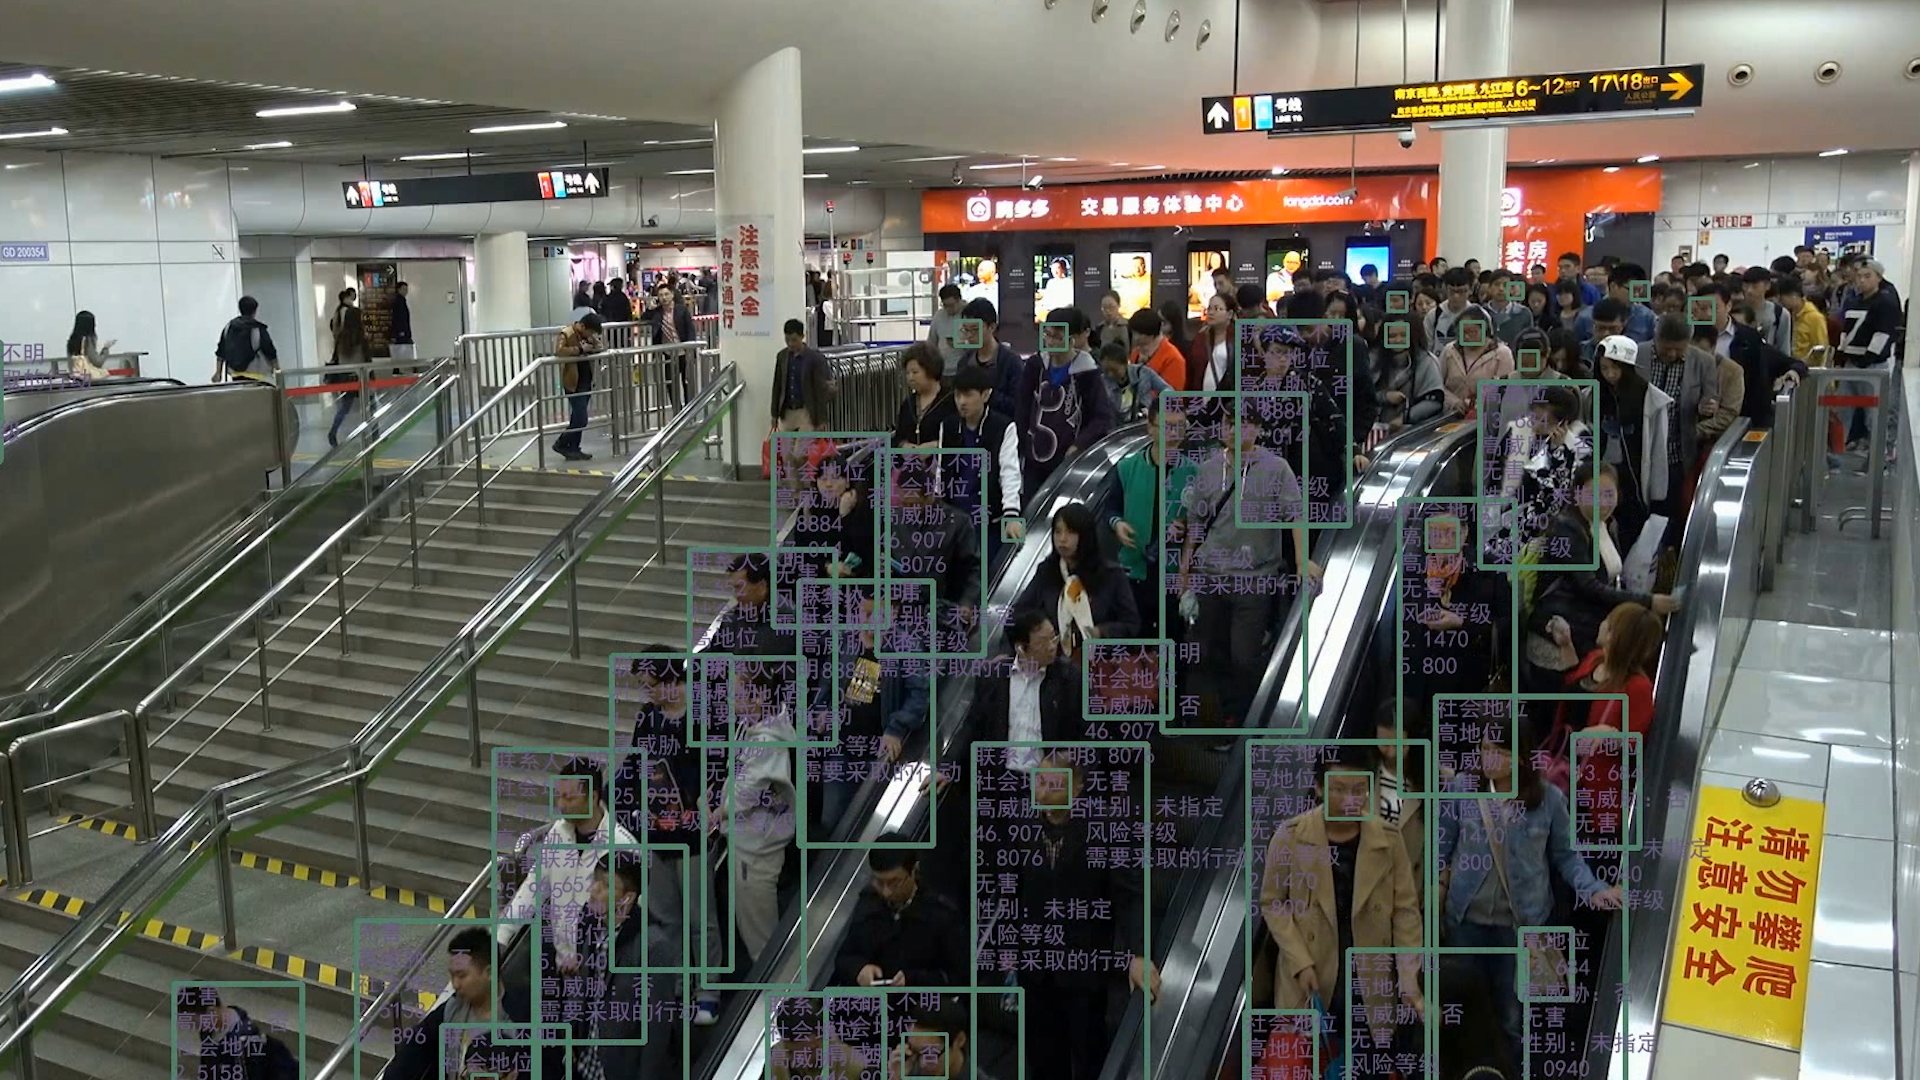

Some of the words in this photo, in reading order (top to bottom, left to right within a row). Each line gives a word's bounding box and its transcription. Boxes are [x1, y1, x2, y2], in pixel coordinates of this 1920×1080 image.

[3, 247, 16, 258] GD
[17, 245, 45, 257] 200354
[1842, 211, 1852, 225] 5
[720, 238, 734, 329] 有序通行
[739, 224, 760, 316] 注意安全
[1683, 815, 1753, 987] 注意安全
[1742, 825, 1810, 1000] 请勿攀爬
